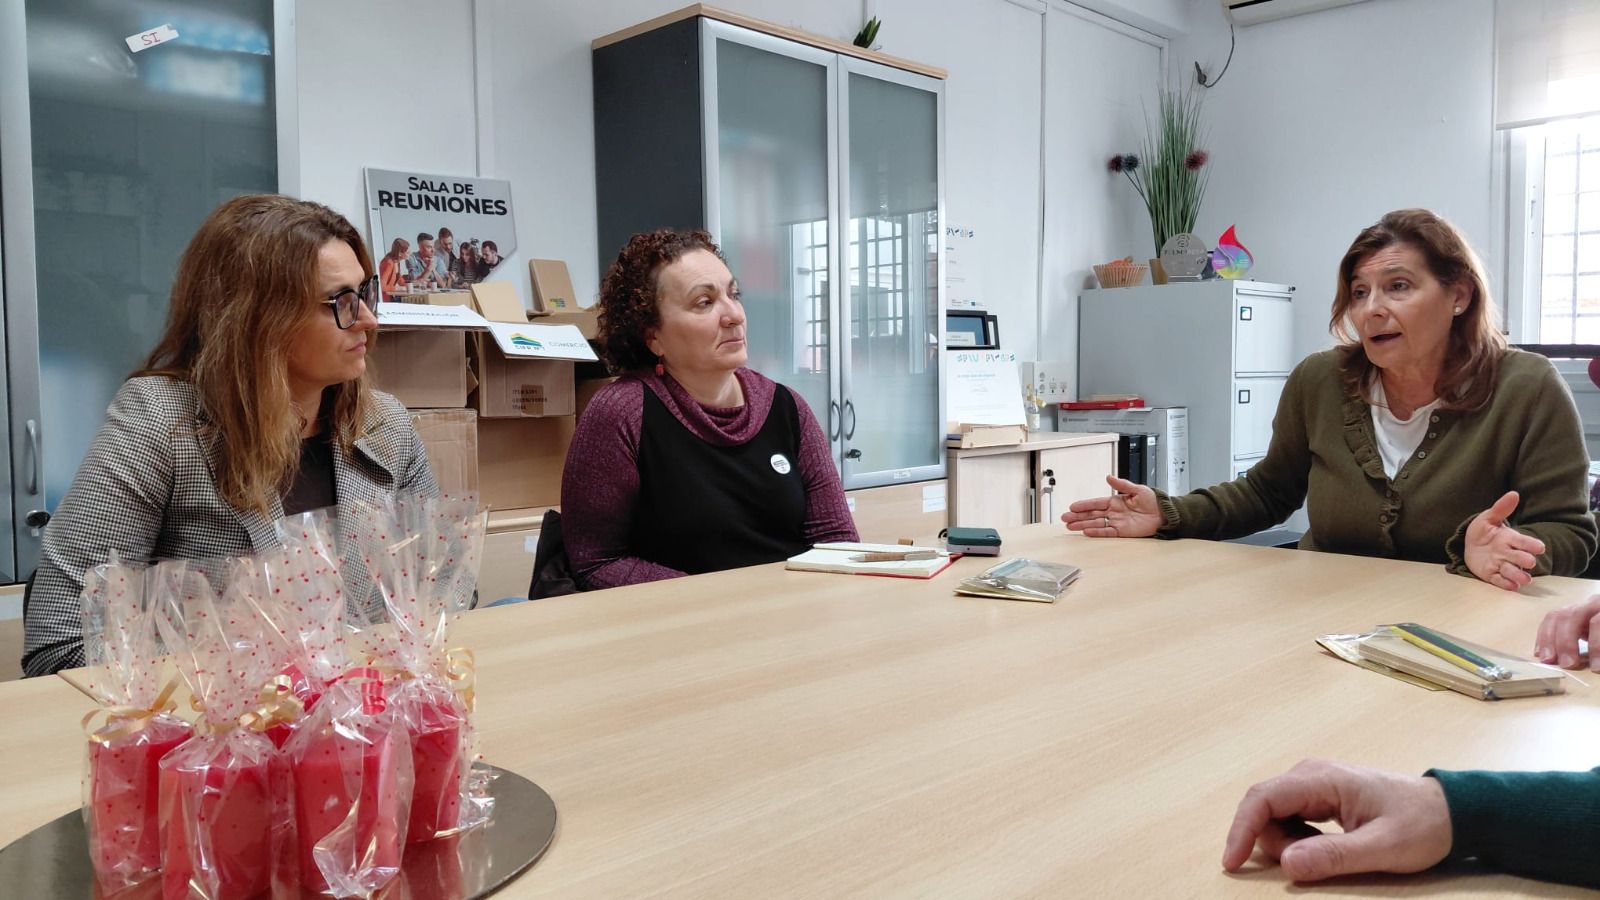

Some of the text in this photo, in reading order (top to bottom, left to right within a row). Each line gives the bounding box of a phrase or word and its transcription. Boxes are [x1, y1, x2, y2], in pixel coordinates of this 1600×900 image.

[408, 176, 474, 195] SALA DE
[378, 190, 507, 216] REUNIONES
